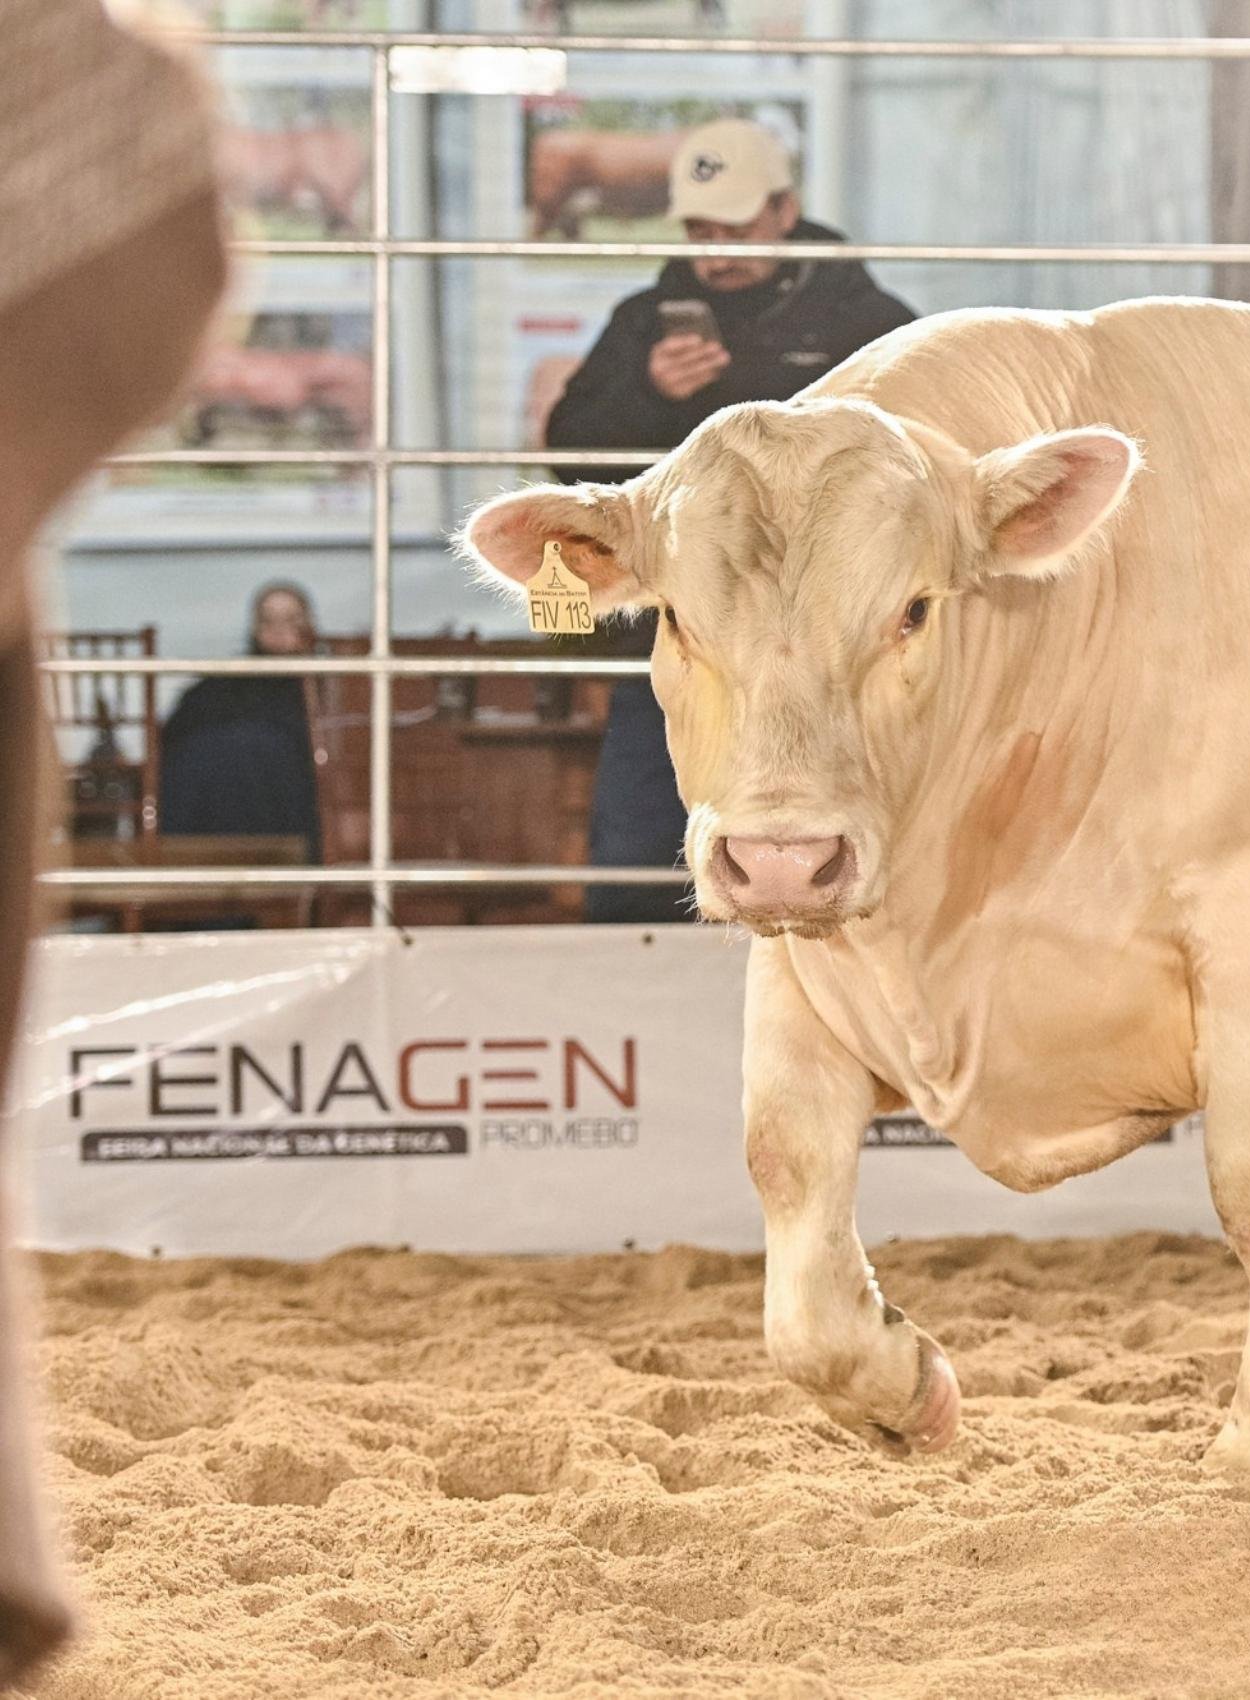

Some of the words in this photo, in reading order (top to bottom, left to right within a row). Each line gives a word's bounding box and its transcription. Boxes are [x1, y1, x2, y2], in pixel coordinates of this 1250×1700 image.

[531, 600, 559, 629] FIV
[566, 600, 591, 629] 113
[70, 1038, 636, 1118] FENAGEN
[98, 1135, 166, 1158] FEIRA
[295, 1133, 333, 1155] DA
[480, 1117, 638, 1149] PROMEBO
